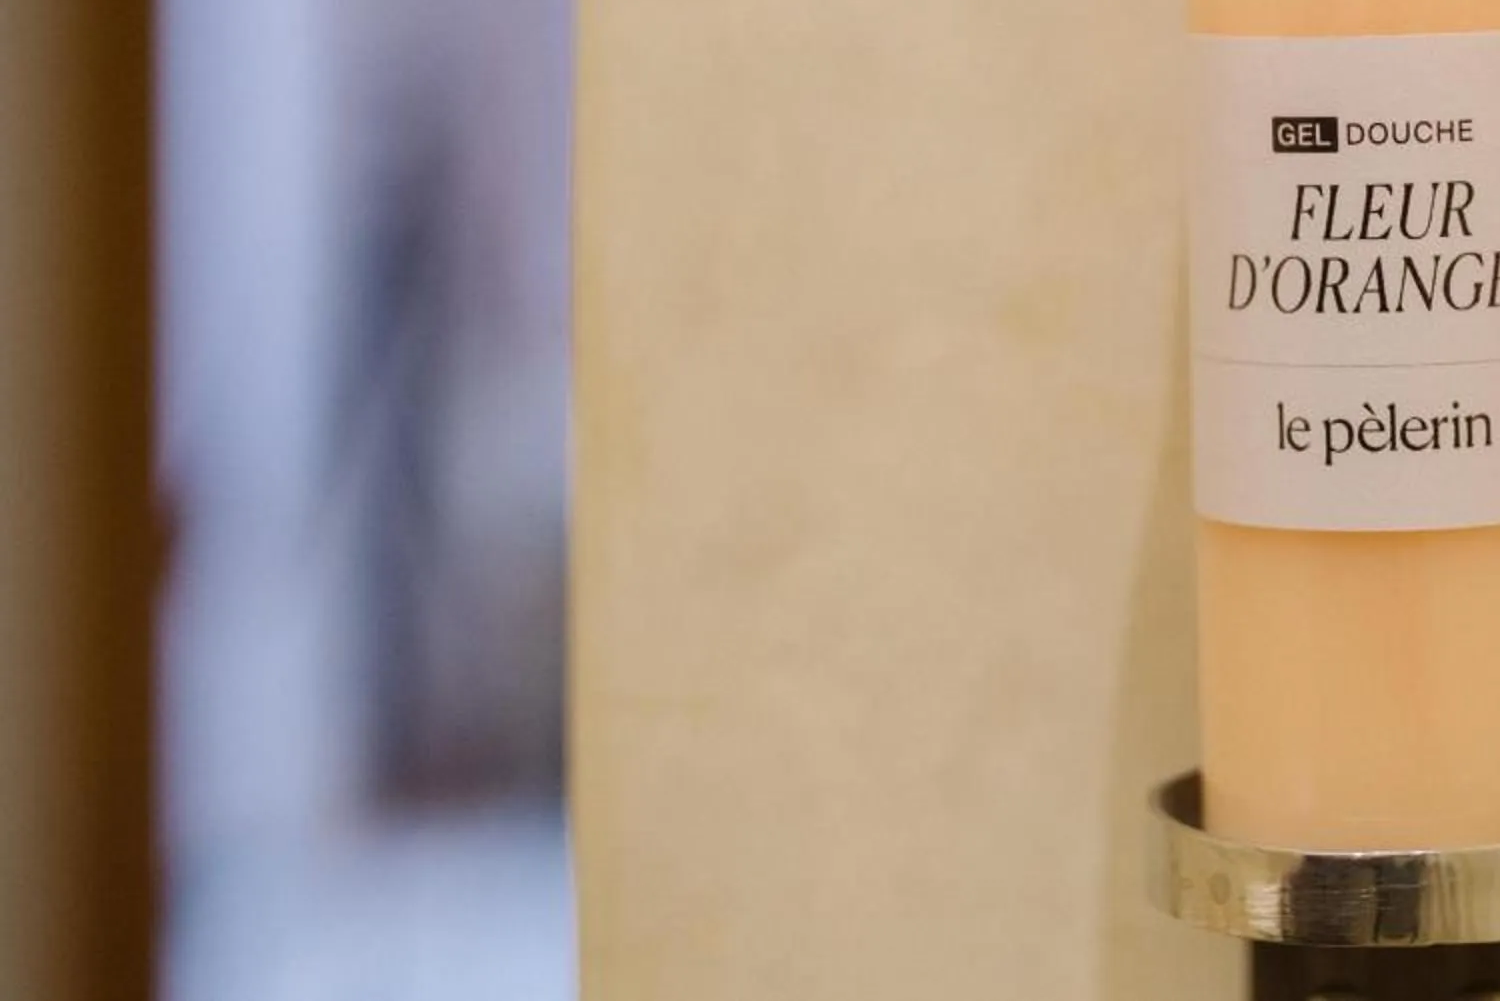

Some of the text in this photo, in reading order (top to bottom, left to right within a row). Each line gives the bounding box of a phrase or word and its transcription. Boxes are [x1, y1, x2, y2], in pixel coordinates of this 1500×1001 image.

[1276, 118, 1474, 147] GEL DOUCHE
[1290, 180, 1475, 242] FLEUR
[1276, 400, 1493, 467] le pèlerin
